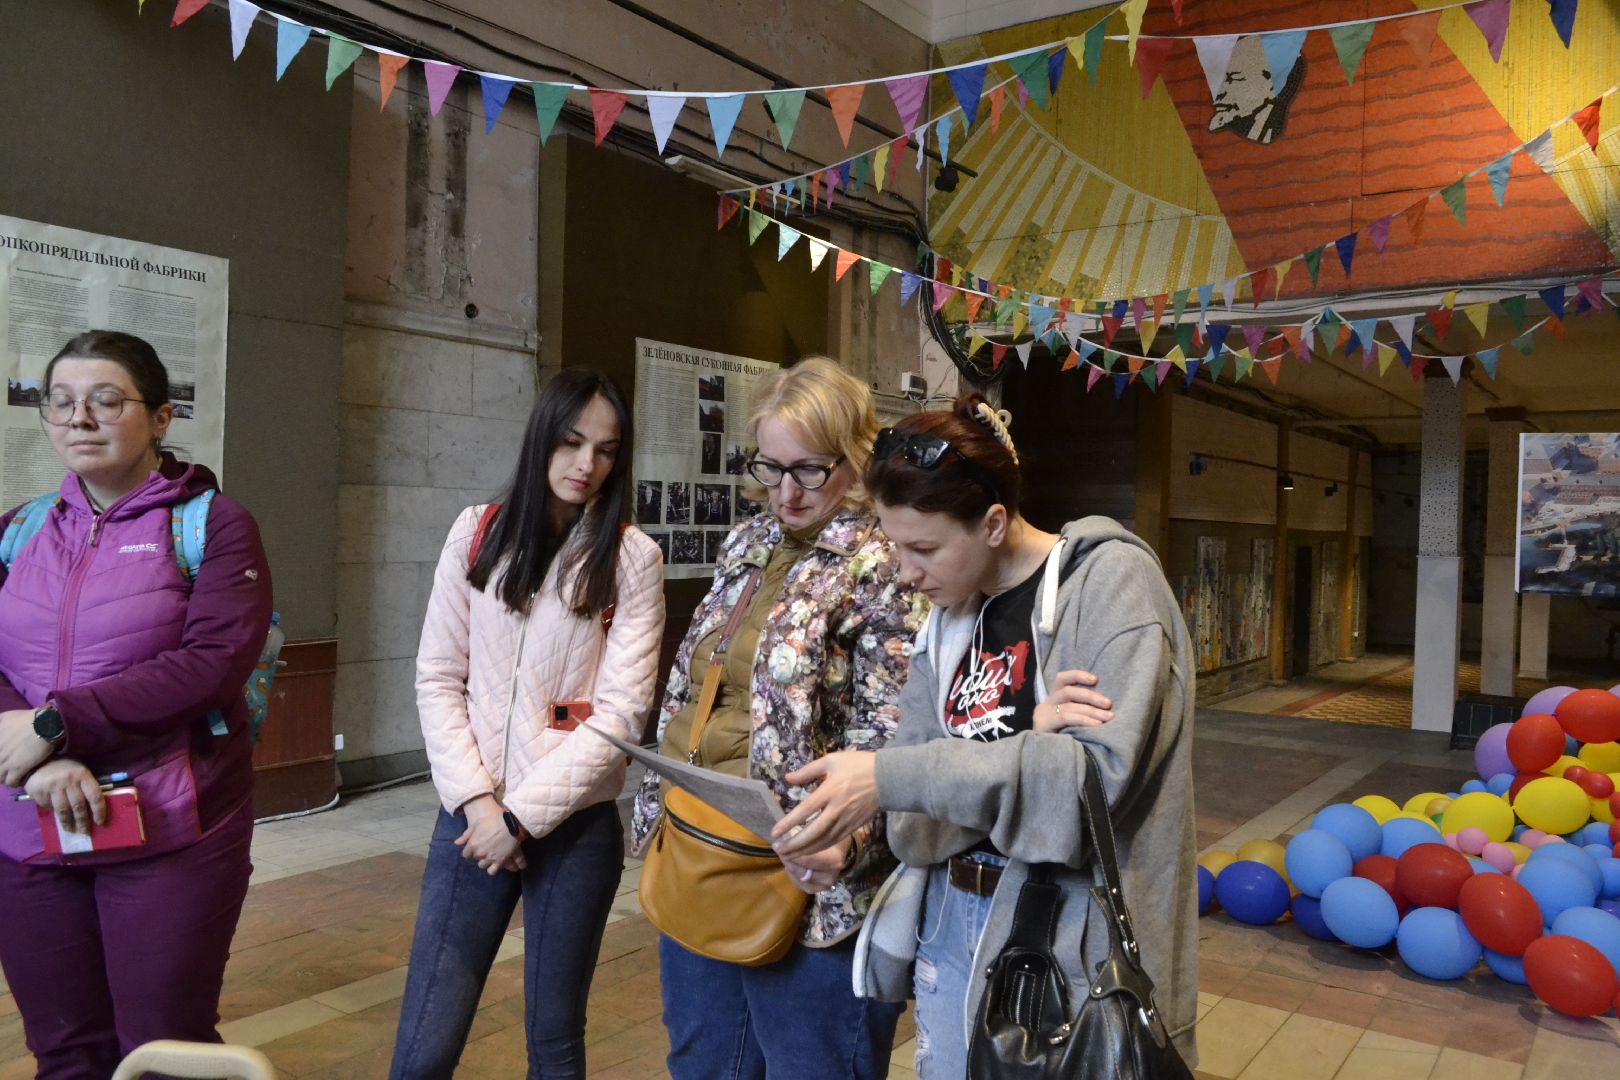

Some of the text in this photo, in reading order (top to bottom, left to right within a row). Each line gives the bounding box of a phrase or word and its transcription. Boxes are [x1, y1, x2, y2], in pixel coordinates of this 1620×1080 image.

[143, 261, 207, 283] ФАБРИКИ
[642, 345, 700, 366] ЗЕЛЁНОВСКАЯ
[701, 356, 742, 373] СУКОННАЯ
